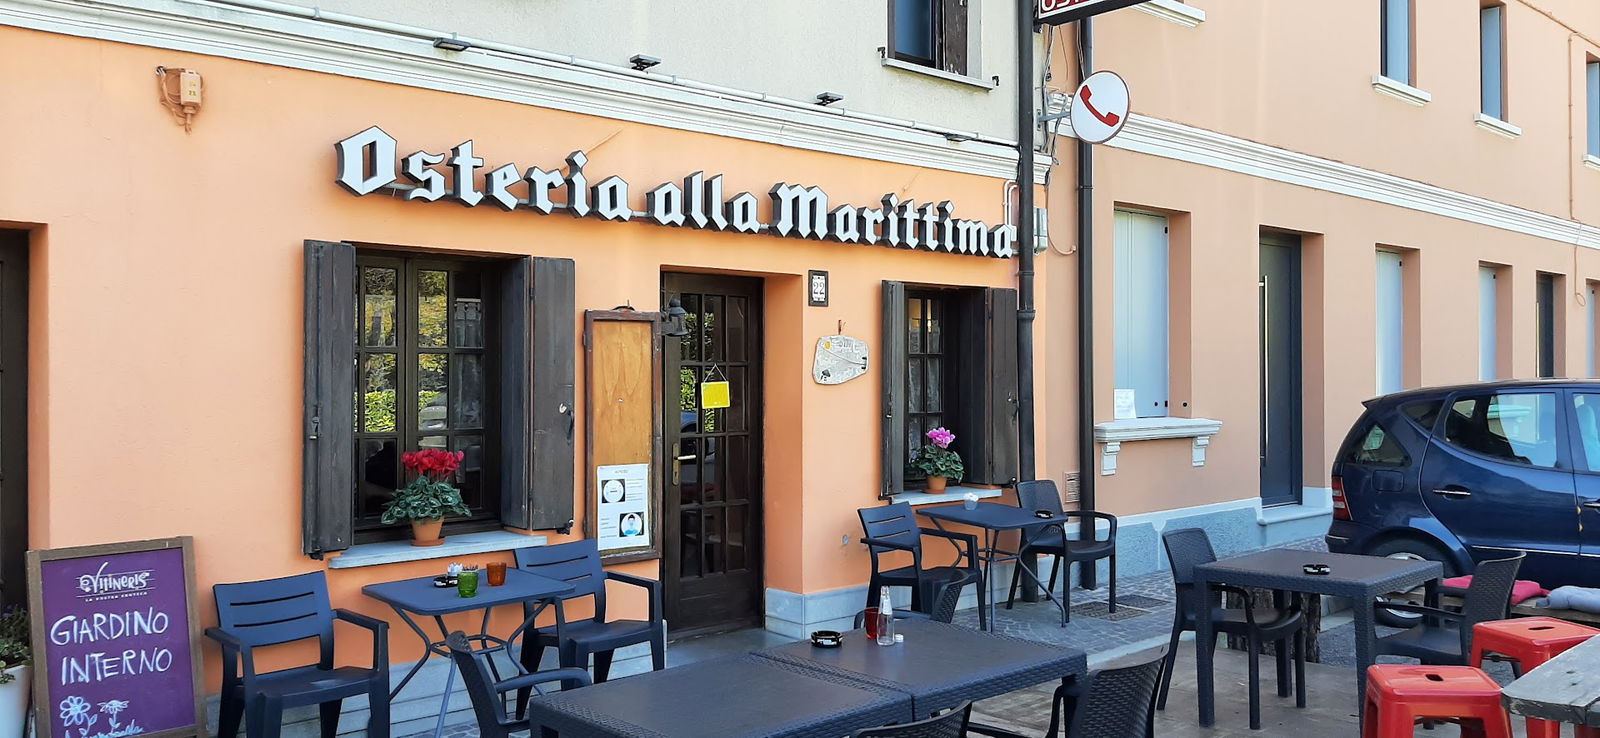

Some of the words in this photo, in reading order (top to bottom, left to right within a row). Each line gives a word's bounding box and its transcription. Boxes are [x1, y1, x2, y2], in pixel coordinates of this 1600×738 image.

[335, 125, 632, 222] Osteria
[646, 171, 760, 234] alla
[768, 182, 1013, 258] Marittima
[813, 281, 825, 295] 22
[50, 607, 168, 645] GIARDINO
[61, 648, 172, 685] INTERNO
